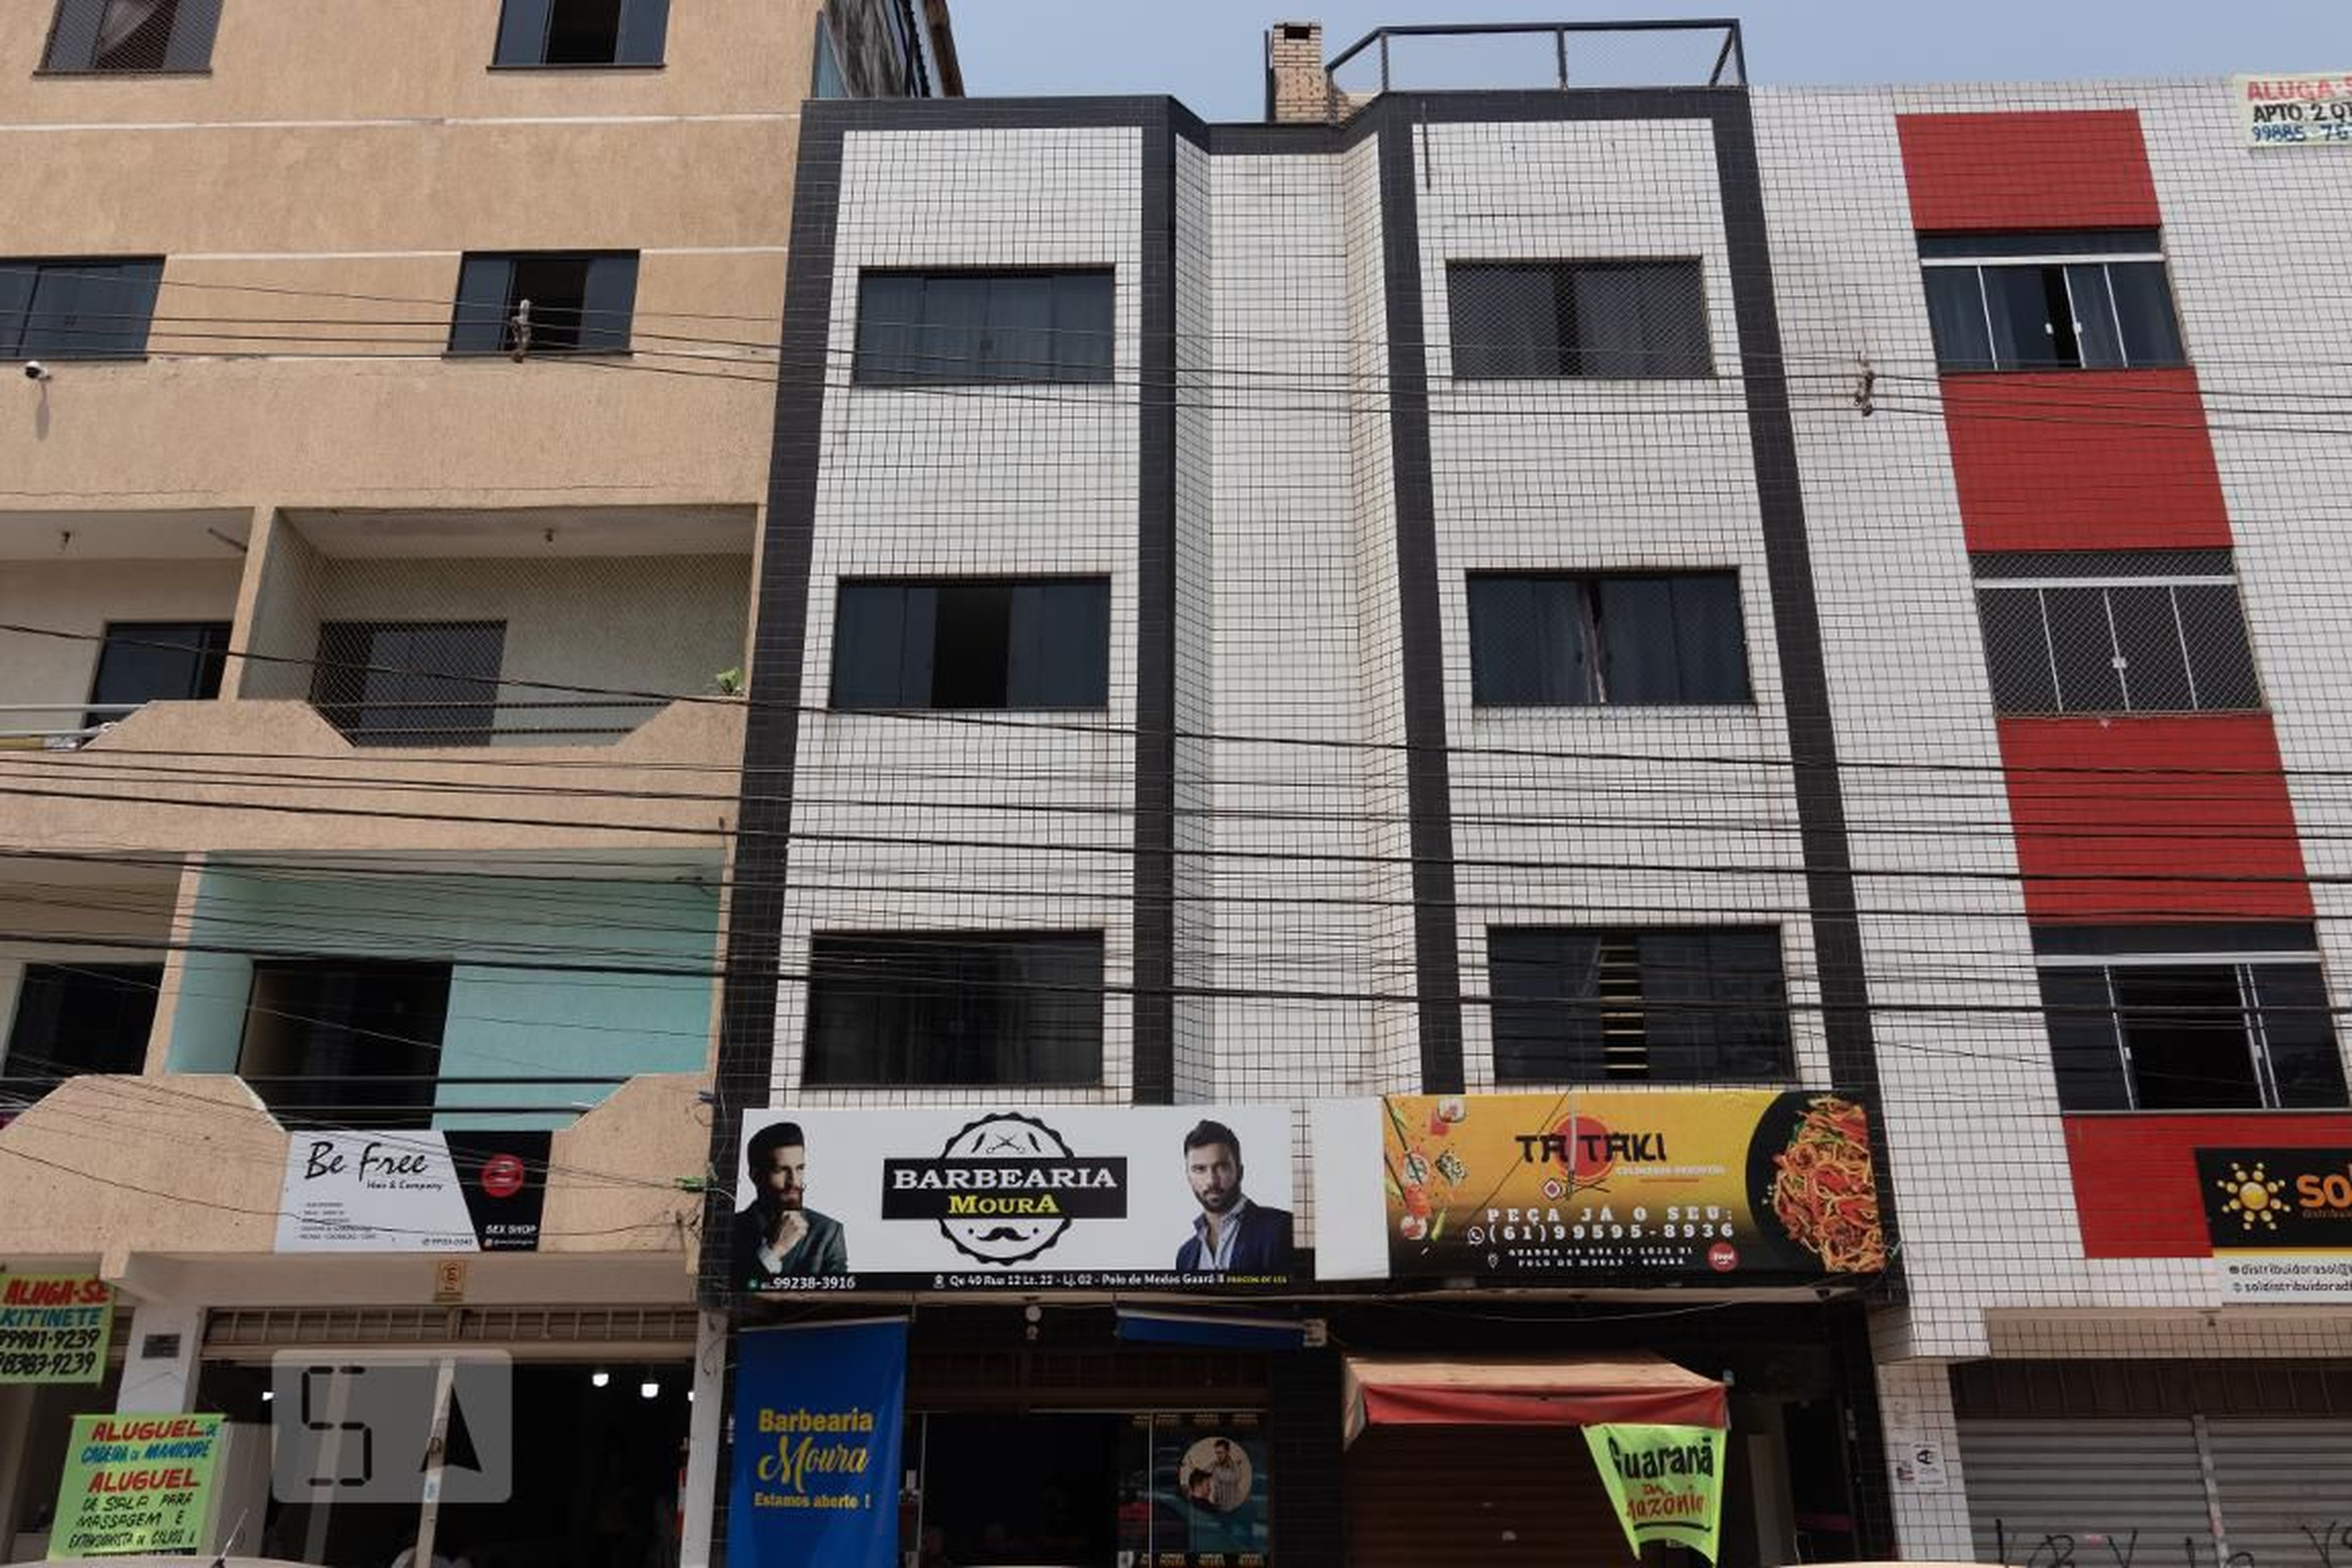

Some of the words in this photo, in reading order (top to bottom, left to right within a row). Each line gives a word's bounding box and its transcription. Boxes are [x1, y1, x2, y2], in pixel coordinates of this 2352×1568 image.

[304, 1141, 349, 1180] Be
[358, 1142, 429, 1182] Free
[892, 1168, 1118, 1189] BARBEARIA
[2296, 1174, 2352, 1208] SO
[1487, 1208, 1561, 1226] PEÇA
[1633, 1206, 1647, 1221] O
[773, 1276, 856, 1290] 99238-3916
[0, 1306, 104, 1328] KITINETE
[92, 1419, 205, 1442] ALUGUEL
[758, 1407, 873, 1432] Barbearia
[757, 1435, 872, 1493] Moura
[88, 1468, 201, 1493] ALUGUEL
[754, 1492, 810, 1508] Estamos
[813, 1494, 859, 1509] aberto
